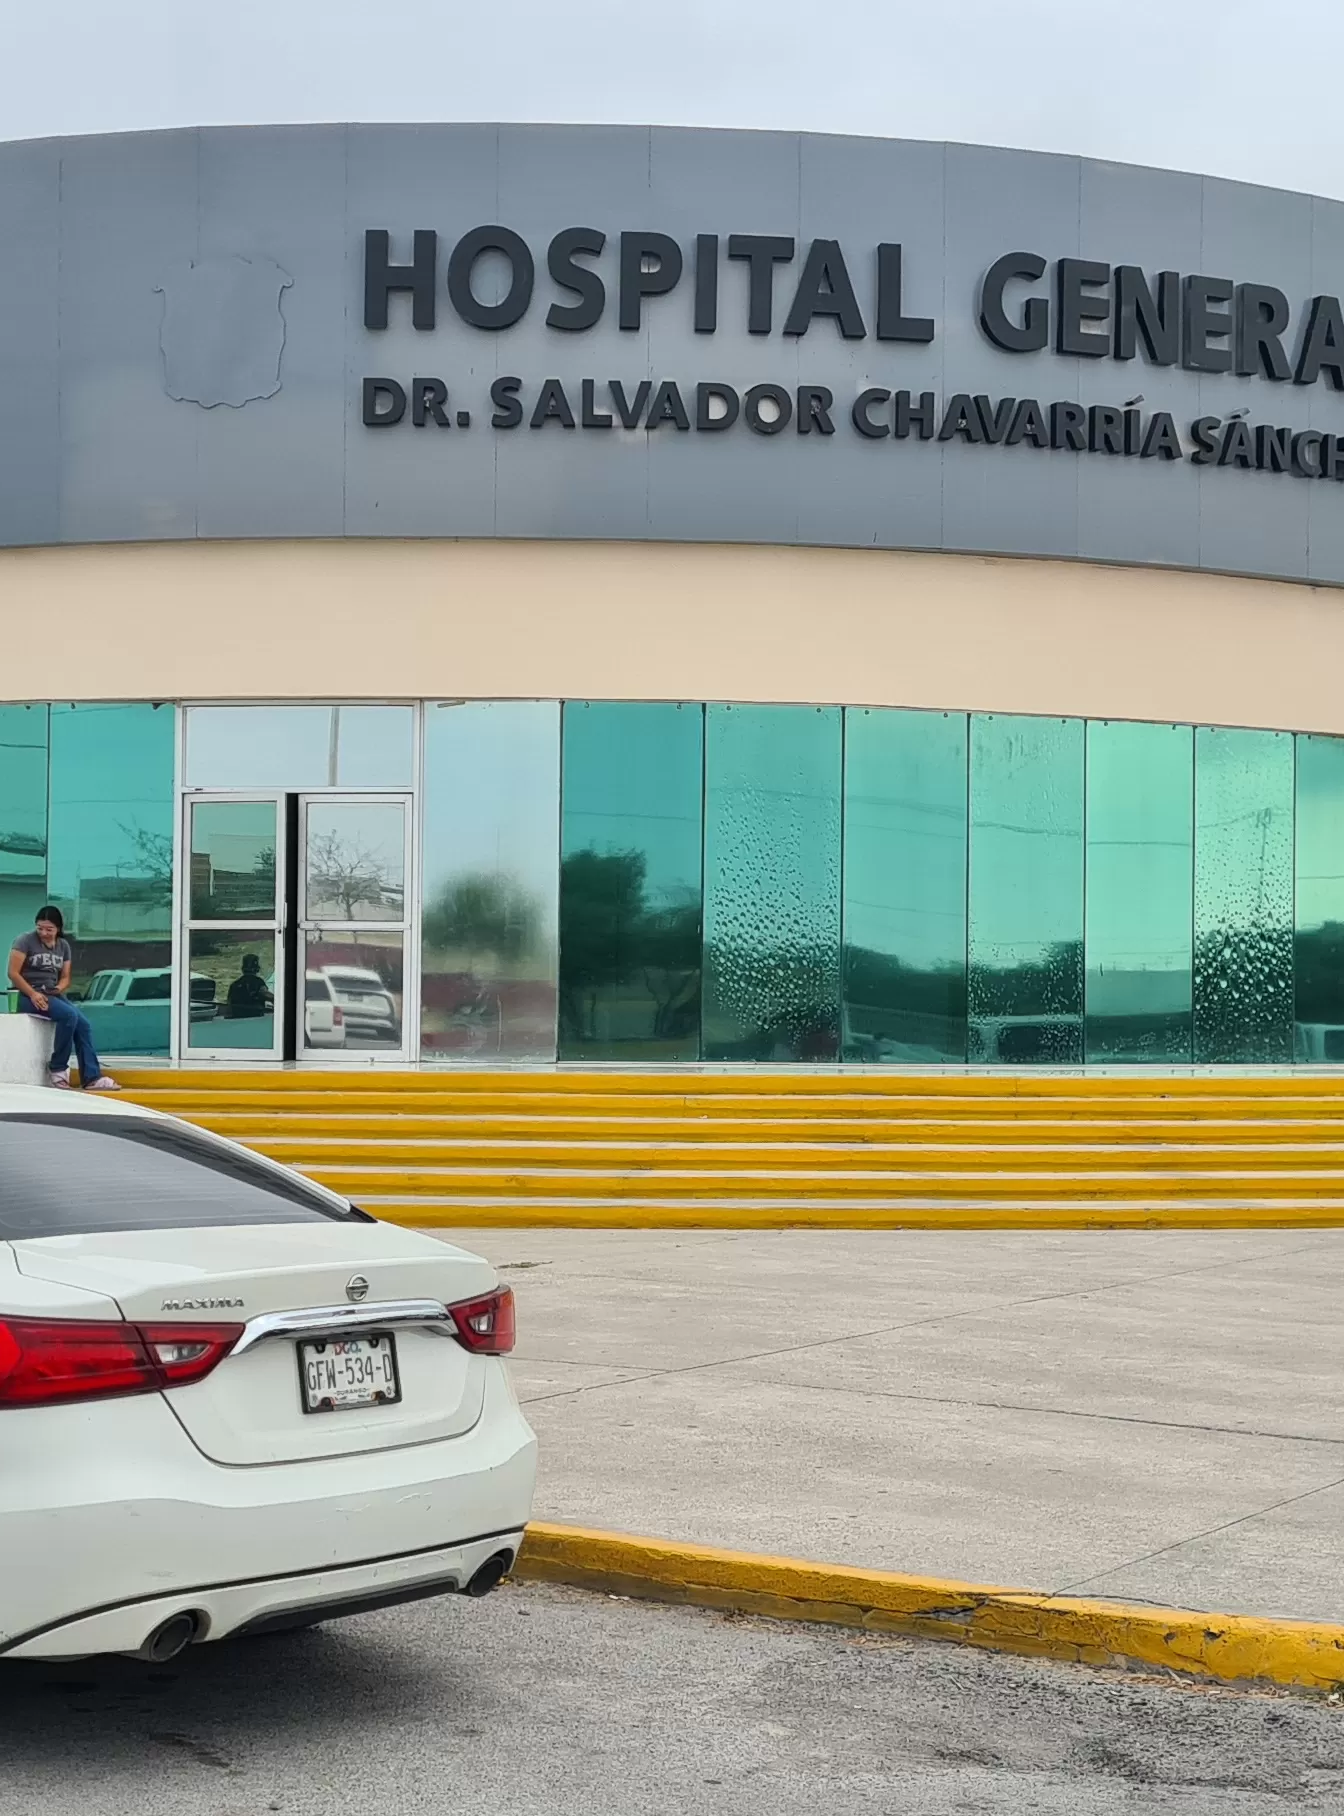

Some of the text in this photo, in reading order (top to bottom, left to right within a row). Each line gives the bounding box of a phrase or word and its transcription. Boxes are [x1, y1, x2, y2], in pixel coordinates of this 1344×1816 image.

[363, 224, 936, 343] HOSPITAL
[362, 376, 470, 429] DR.
[490, 376, 836, 436] SALVADOR
[851, 388, 1183, 460] CHAVARRÍA
[160, 1296, 245, 1312] MAXIMA
[307, 1353, 393, 1391] GFW-534-D
